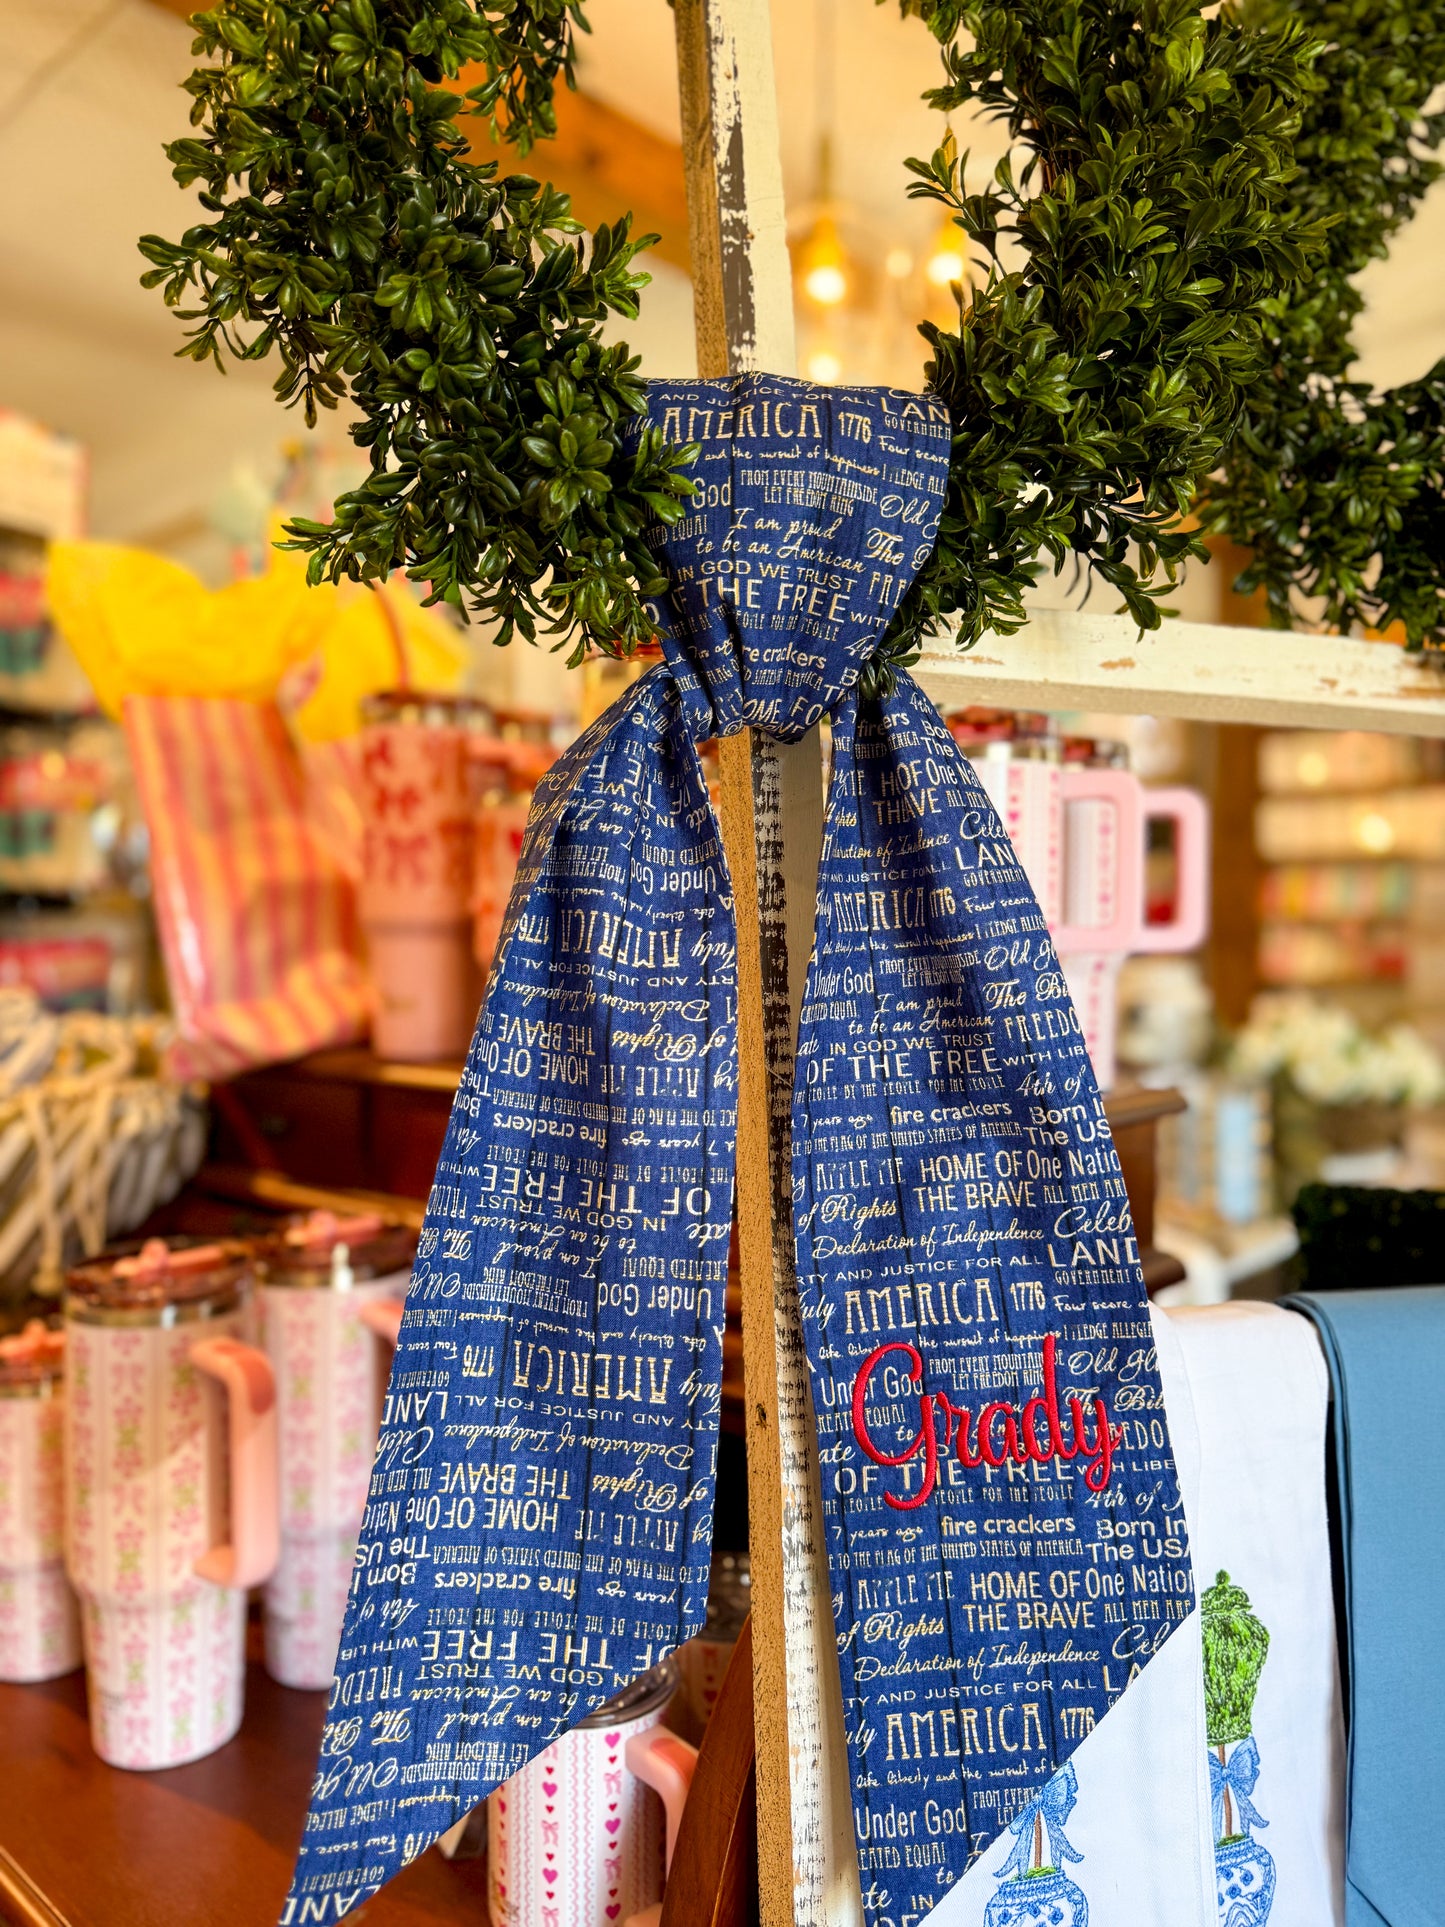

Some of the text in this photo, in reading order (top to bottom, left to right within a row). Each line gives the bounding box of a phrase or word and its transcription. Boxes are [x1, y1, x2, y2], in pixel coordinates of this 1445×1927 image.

[658, 386, 875, 407] AND JUSTICE FOR ALL
[662, 401, 871, 445] AMERICA 1776
[740, 470, 771, 486] FROM
[773, 470, 805, 490] EVERY
[764, 487, 784, 503] LET
[830, 497, 854, 517] RING
[730, 508, 837, 542] I am proud
[696, 529, 868, 572] to be an American
[676, 560, 858, 593] IN GOD WE TRUST
[696, 577, 762, 609] THE
[777, 584, 850, 623] FREE
[762, 643, 827, 670] crackers
[833, 887, 925, 932] AMERICA
[519, 909, 683, 969] AMERICA 1776
[843, 967, 874, 993] God
[982, 979, 1026, 1010] The
[599, 994, 710, 1023] Declaration
[848, 1011, 995, 1036] to be an American
[498, 1013, 563, 1050] BRAVE
[611, 1024, 696, 1062] Rights
[830, 1033, 996, 1054] IN GOD WE TRUST
[500, 1048, 589, 1086] HOME OF
[848, 1048, 1002, 1079] THE FREE
[1003, 1052, 1051, 1067] WITH
[890, 1101, 1013, 1125] fire crackers
[494, 1113, 607, 1149] fire crackers
[890, 1121, 1022, 1147] UNITED STATES OF AMERICA
[920, 1151, 1024, 1182] HOME OF
[1027, 1150, 1062, 1178] One
[480, 1164, 711, 1215] OF THE FREE
[913, 1182, 1036, 1213] THE BRAVE
[476, 1194, 665, 1231] IN GOD WE TRUST
[798, 1193, 897, 1234] of Rights
[812, 1218, 1045, 1259] Declaration of Independence
[835, 1254, 1043, 1282] AND JUSTICE FOR ALL
[597, 1283, 712, 1320] Under God
[844, 1278, 1046, 1334] AMERICA 1776
[462, 1339, 673, 1404] AMERICA 1776
[1068, 1351, 1116, 1374] Old
[454, 1395, 674, 1426] AND JUSTICE FOR ALL
[852, 1334, 1123, 1511] Grady
[443, 1415, 694, 1470] Declaration of Independence
[439, 1462, 571, 1500] THE BRAVE
[985, 1456, 1074, 1484] FREE
[591, 1468, 677, 1512] Rights
[407, 1495, 440, 1530] One
[443, 1497, 557, 1531] HOME OF
[941, 1515, 1076, 1536] fire crackers
[1098, 1519, 1152, 1539] Born
[433, 1545, 581, 1571] UNITED STATES OF AMERICA
[941, 1538, 1083, 1559] UNITED STATES OF AMERICA
[1085, 1541, 1134, 1562] The
[434, 1572, 576, 1600] fire crackers
[970, 1569, 1081, 1600] HOME OF
[1085, 1567, 1125, 1599] One
[836, 1611, 945, 1654] of Rights
[962, 1601, 1096, 1633] THE BRAVE
[420, 1630, 613, 1670] THE FREE
[854, 1641, 1100, 1682] Declaration of Independence
[414, 1663, 604, 1686] GOD WE TRUST
[877, 1677, 1097, 1703] AND JUSTICE FOR ALL
[409, 1685, 577, 1715] be an American
[438, 1704, 569, 1740] I am proud
[885, 1702, 1096, 1761] AMERICA 1776
[426, 1741, 528, 1762] LET FREEDOM RING
[855, 1798, 966, 1840] Under God
